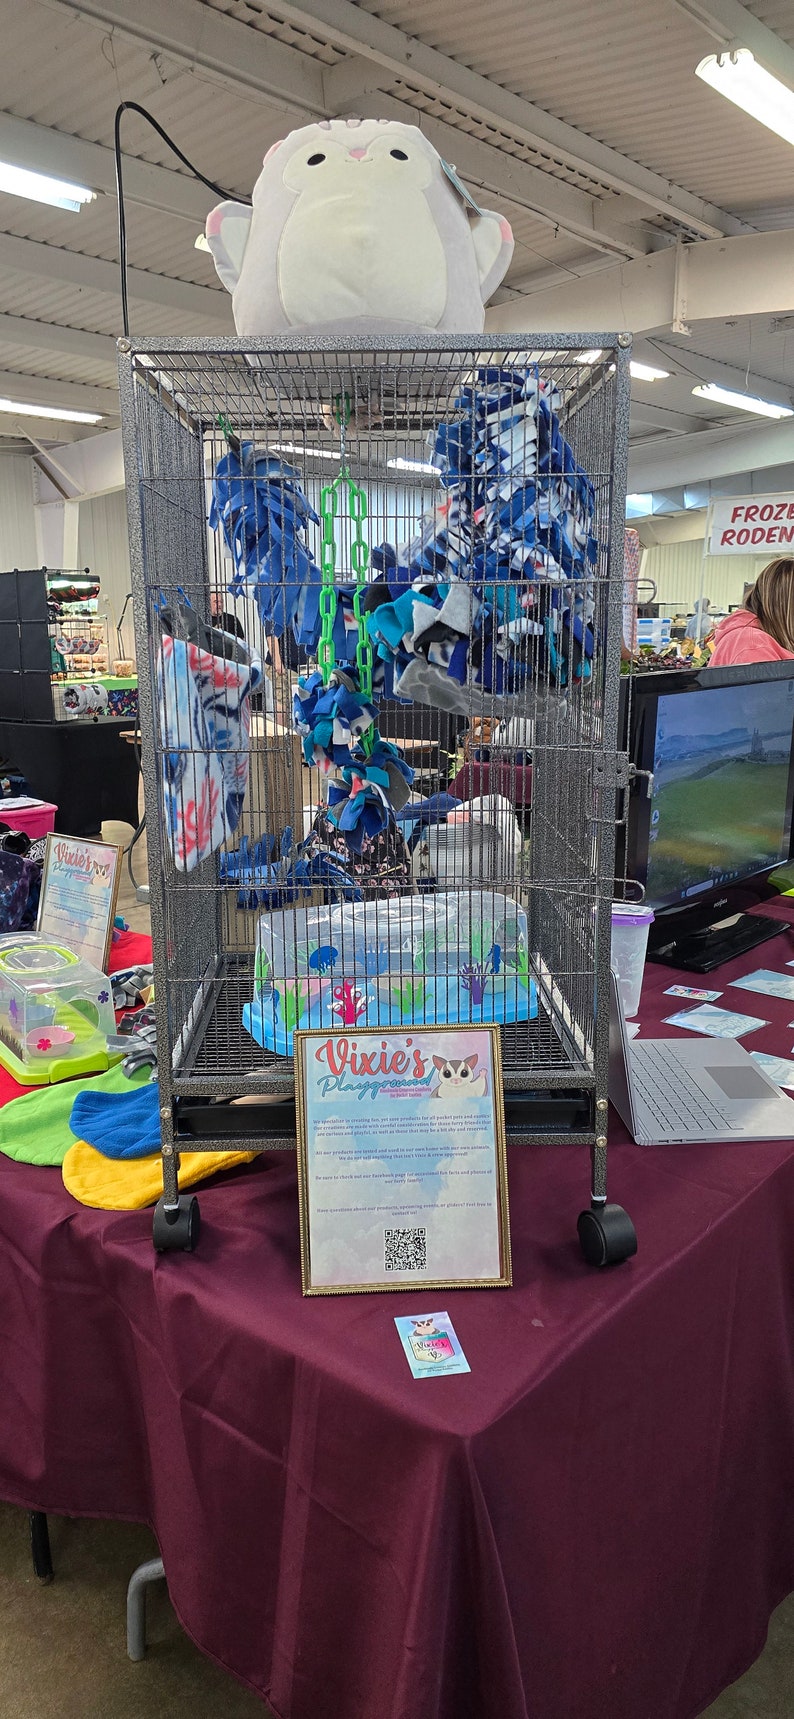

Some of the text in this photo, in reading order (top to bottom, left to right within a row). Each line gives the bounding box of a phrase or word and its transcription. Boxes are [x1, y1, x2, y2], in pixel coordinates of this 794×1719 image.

[54, 842, 92, 872] Vixie's
[315, 1037, 430, 1078] Vixie's
[317, 1066, 436, 1100] Playground
